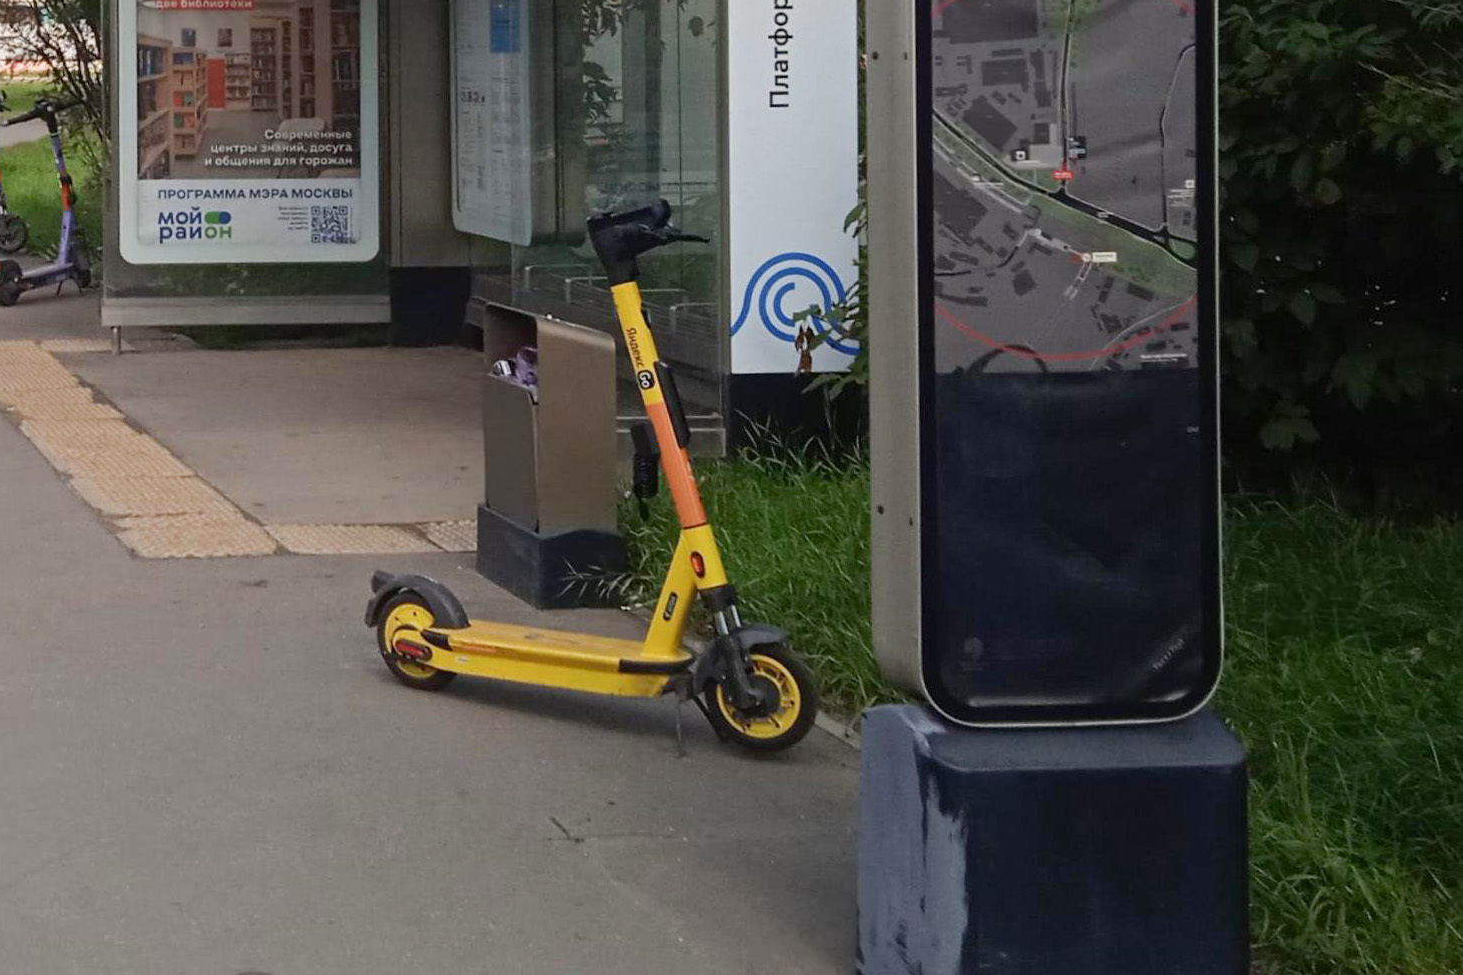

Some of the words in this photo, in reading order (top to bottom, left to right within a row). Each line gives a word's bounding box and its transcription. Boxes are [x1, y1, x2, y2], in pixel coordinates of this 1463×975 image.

[154, 0, 177, 10] две
[265, 129, 353, 142] Современные
[210, 144, 258, 155] центры
[261, 143, 307, 153] знаний,
[309, 144, 353, 155] досуга
[204, 157, 212, 166] и
[215, 155, 271, 168] общения
[273, 157, 297, 168] для
[299, 156, 353, 168] горожан
[158, 189, 246, 200] ПРОГРАММА
[249, 189, 289, 199] МЭРА
[292, 188, 353, 199] МОСКВЫ
[626, 327, 644, 370] Яндекс
[639, 372, 651, 388] Go
